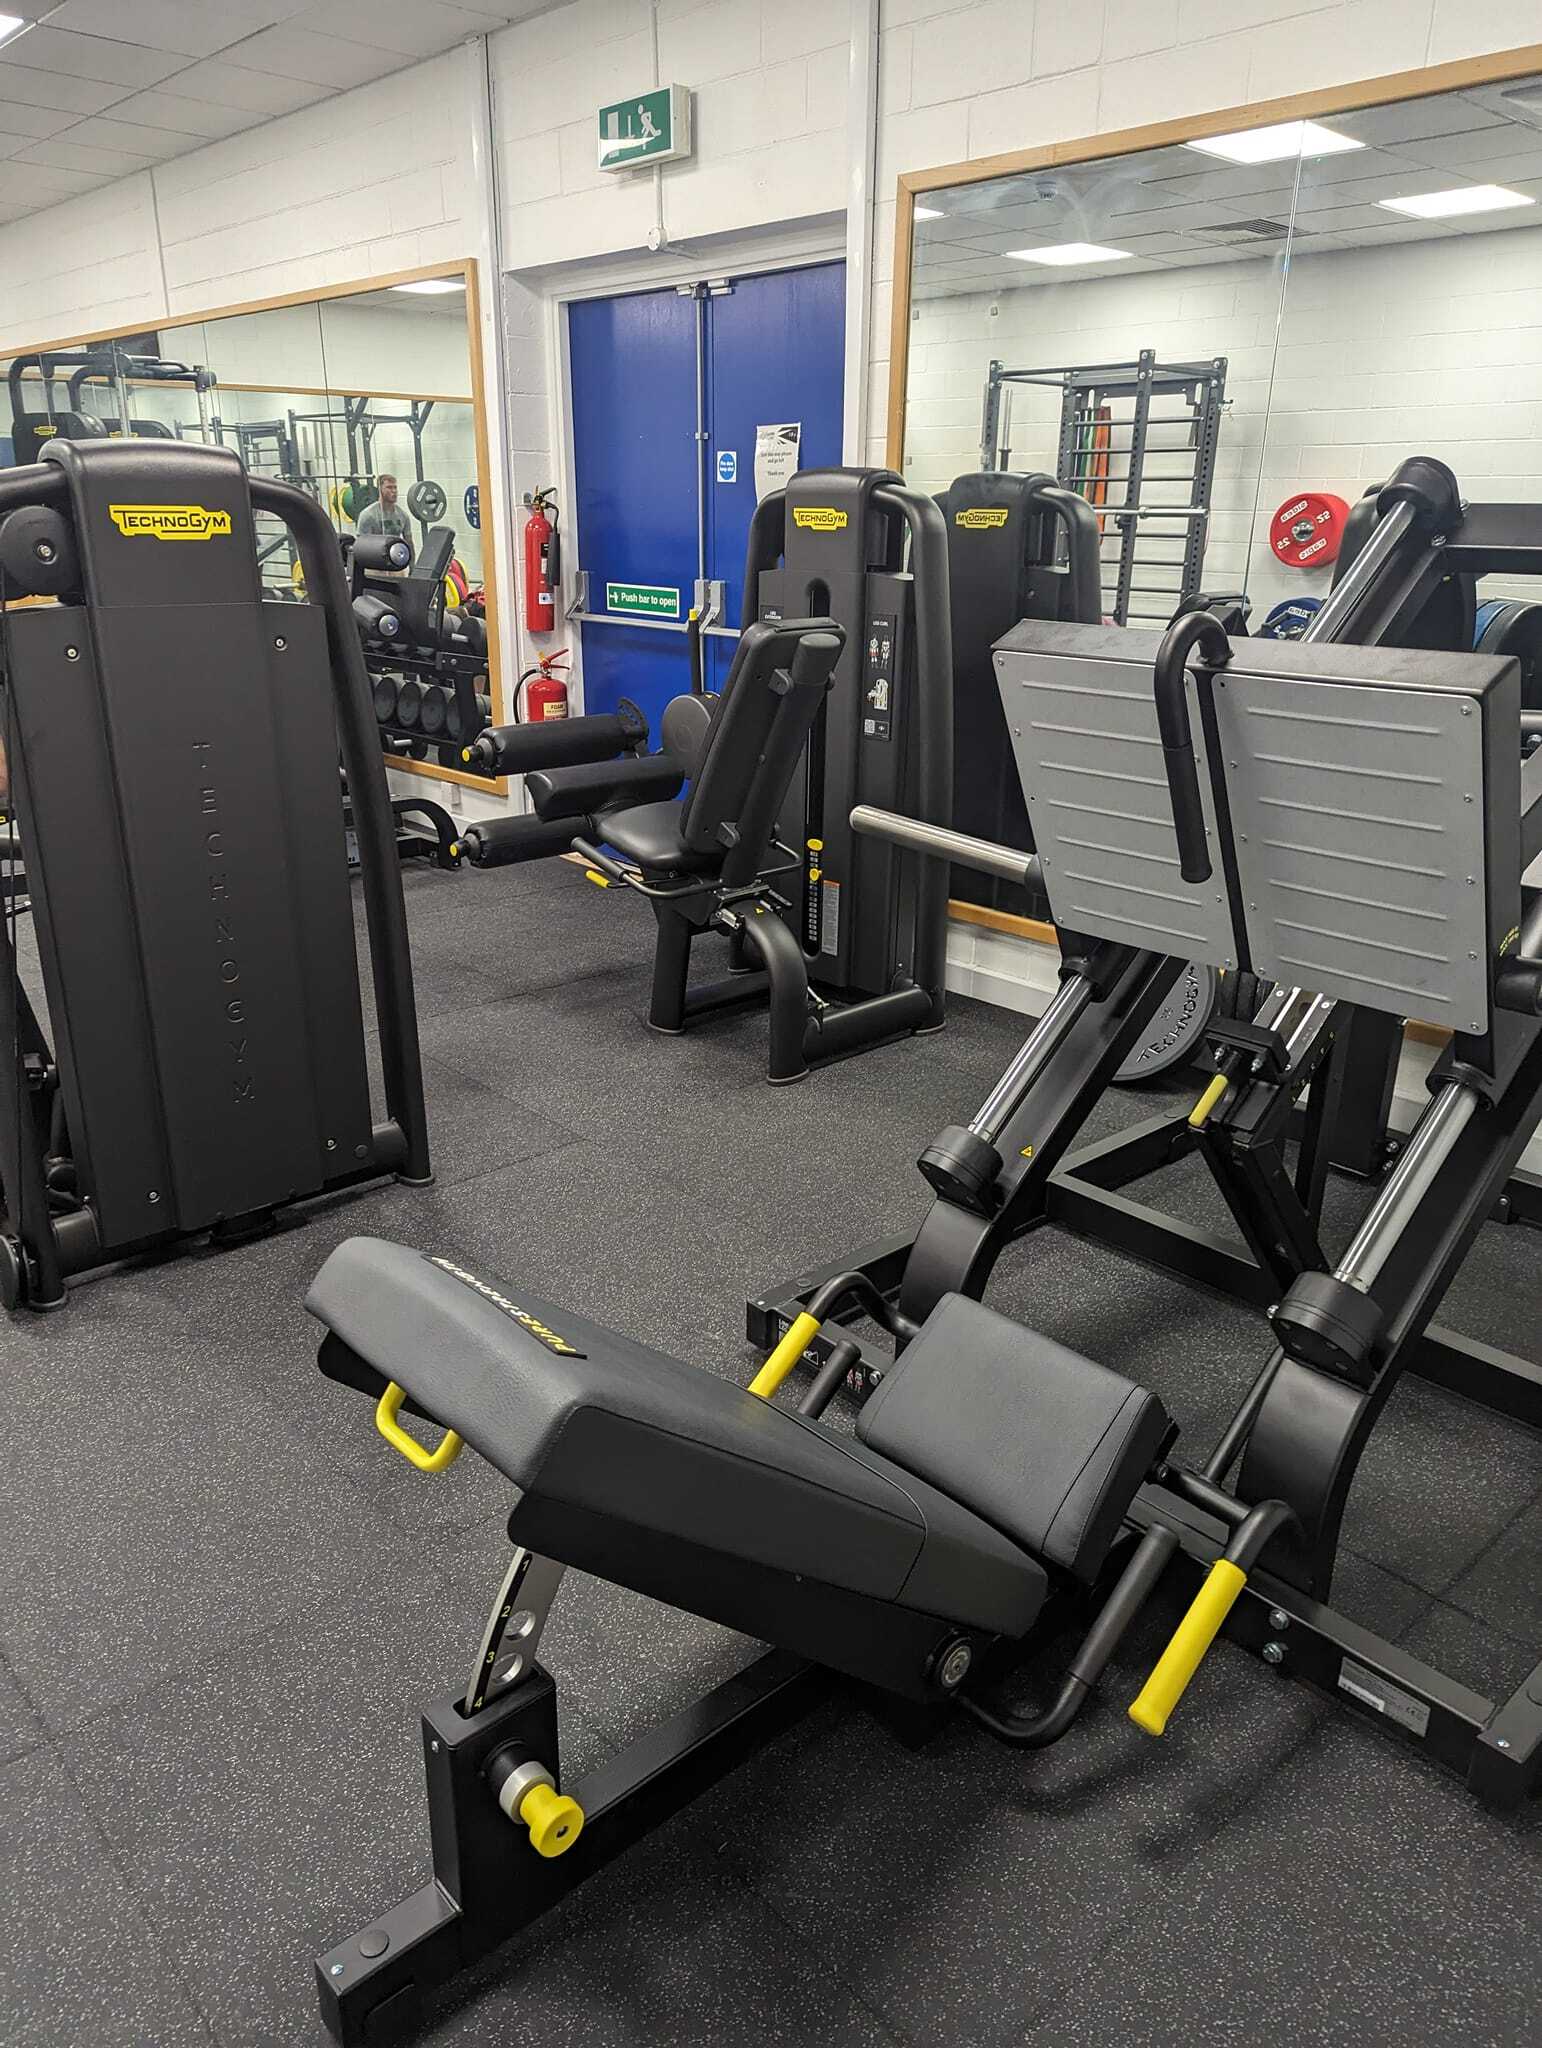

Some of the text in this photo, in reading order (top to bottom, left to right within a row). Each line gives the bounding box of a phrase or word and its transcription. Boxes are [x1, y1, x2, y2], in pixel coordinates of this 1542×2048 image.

[111, 508, 227, 533] TECHNOGYM
[797, 510, 846, 527] TECHNOGYM
[621, 592, 677, 608] Push bar to open
[522, 1560, 531, 1572] 1
[501, 1605, 511, 1618] 2
[486, 1651, 495, 1664] 3
[474, 1697, 483, 1708] 4
